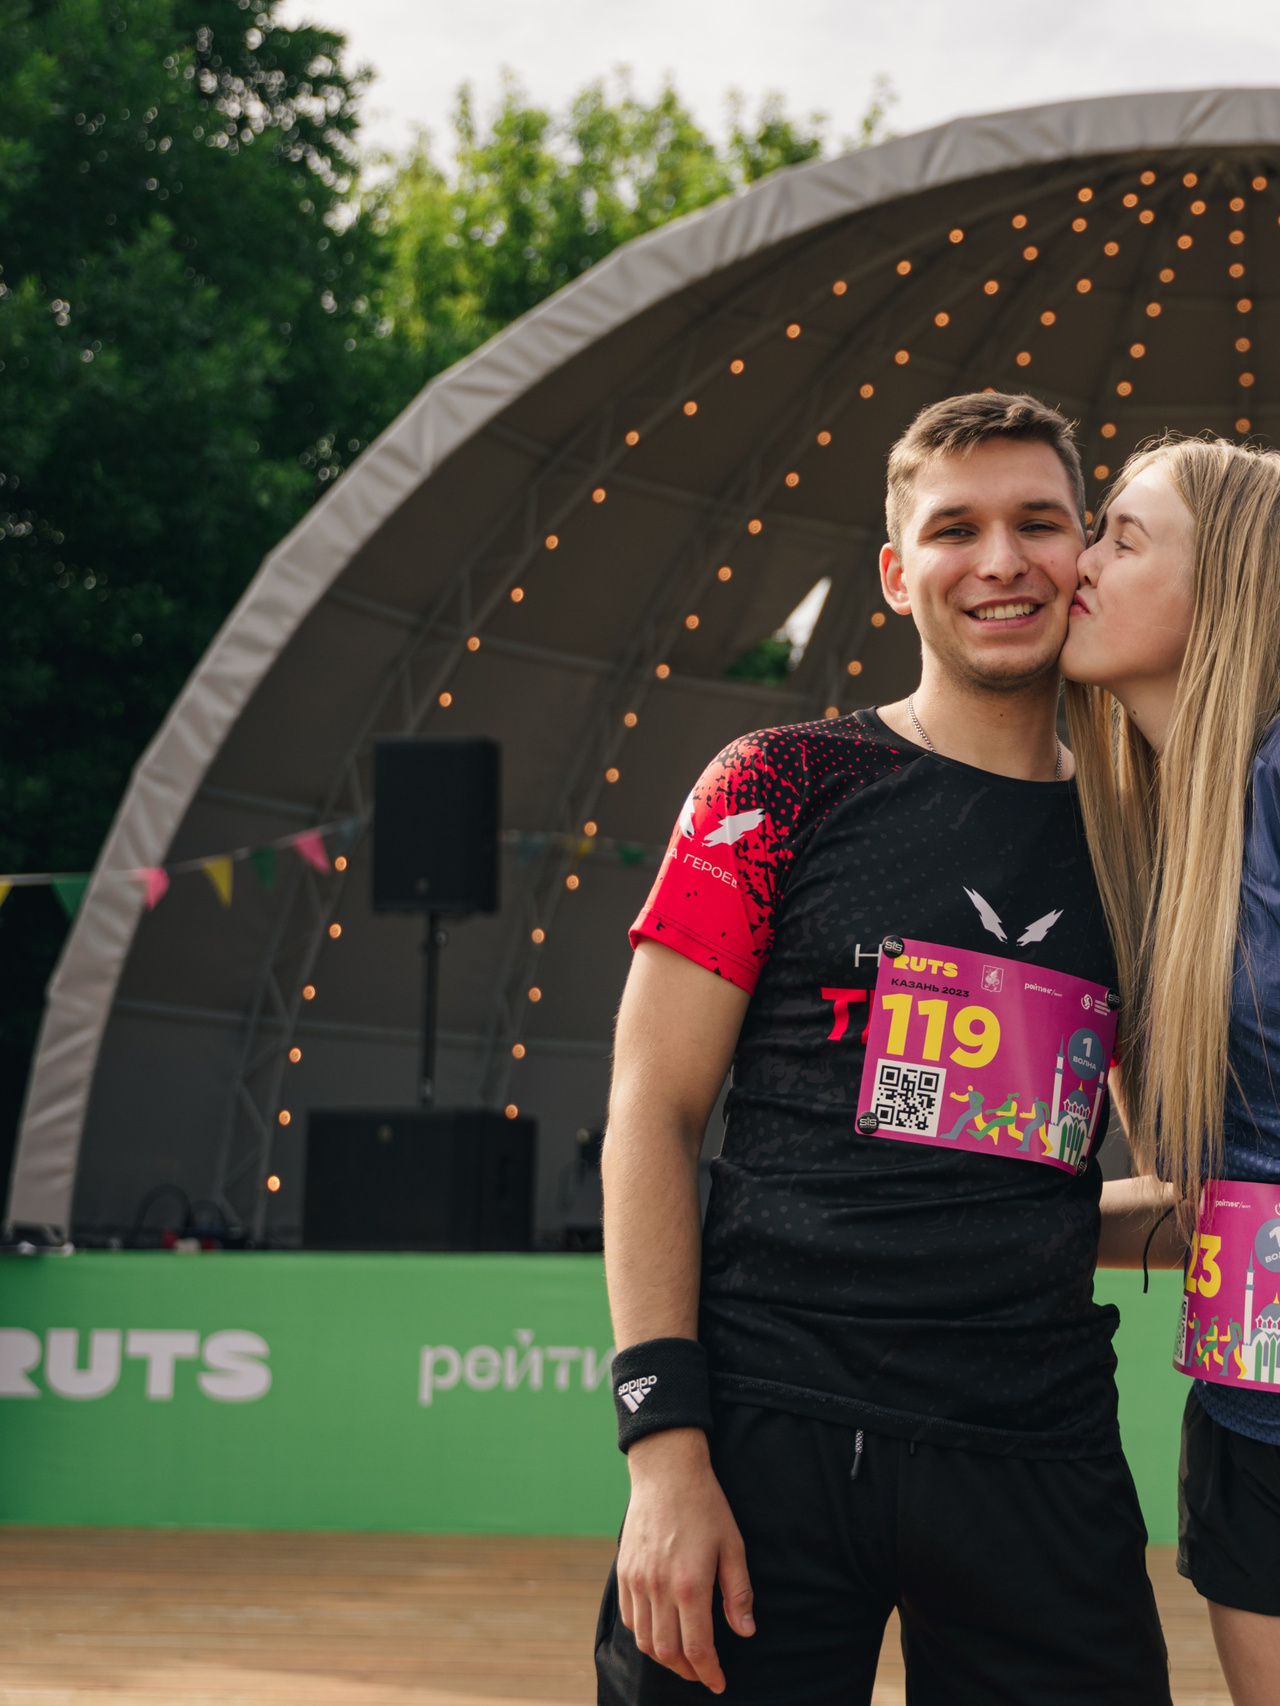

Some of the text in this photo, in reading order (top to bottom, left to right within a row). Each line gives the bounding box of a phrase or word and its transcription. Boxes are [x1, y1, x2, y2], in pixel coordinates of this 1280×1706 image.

[893, 954, 958, 978] RUTS
[891, 978, 970, 998] КАЗАНЬ 2023
[882, 992, 1001, 1069] 119
[1082, 1037, 1093, 1058] 1
[1072, 1055, 1097, 1070] ВОЛНА
[419, 1328, 614, 1408] рейти
[618, 1375, 658, 1396] adidas
